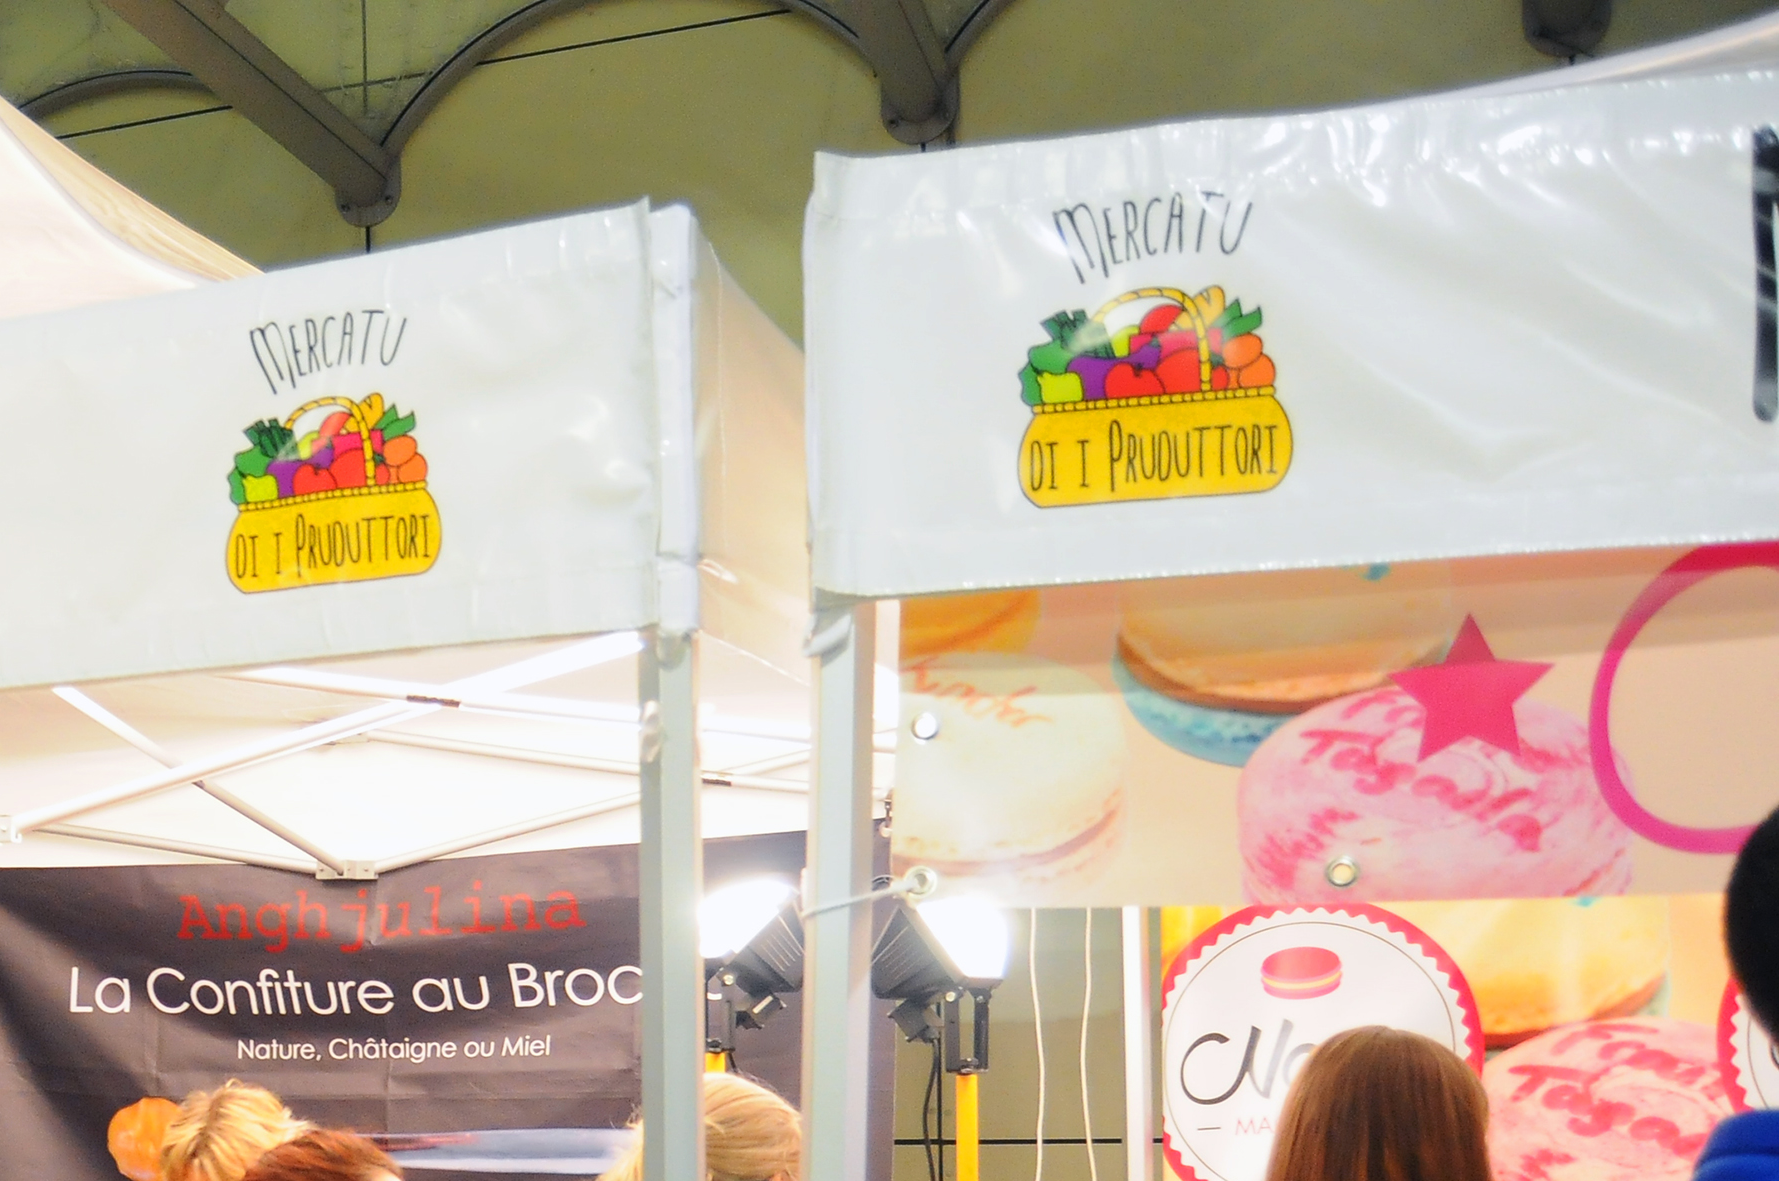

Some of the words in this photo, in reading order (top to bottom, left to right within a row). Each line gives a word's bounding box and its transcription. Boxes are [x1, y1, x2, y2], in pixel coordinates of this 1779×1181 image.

[1053, 191, 1253, 285] MERCATU
[250, 309, 408, 395] MERCATU
[177, 880, 587, 954] Anghjulina
[69, 965, 132, 1014] La
[146, 965, 395, 1016] Confiture
[411, 974, 491, 1012] au
[237, 1038, 323, 1062] Nature,
[328, 1036, 458, 1065] Châtaigne
[464, 1040, 497, 1058] ou
[502, 1034, 551, 1058] Miel
